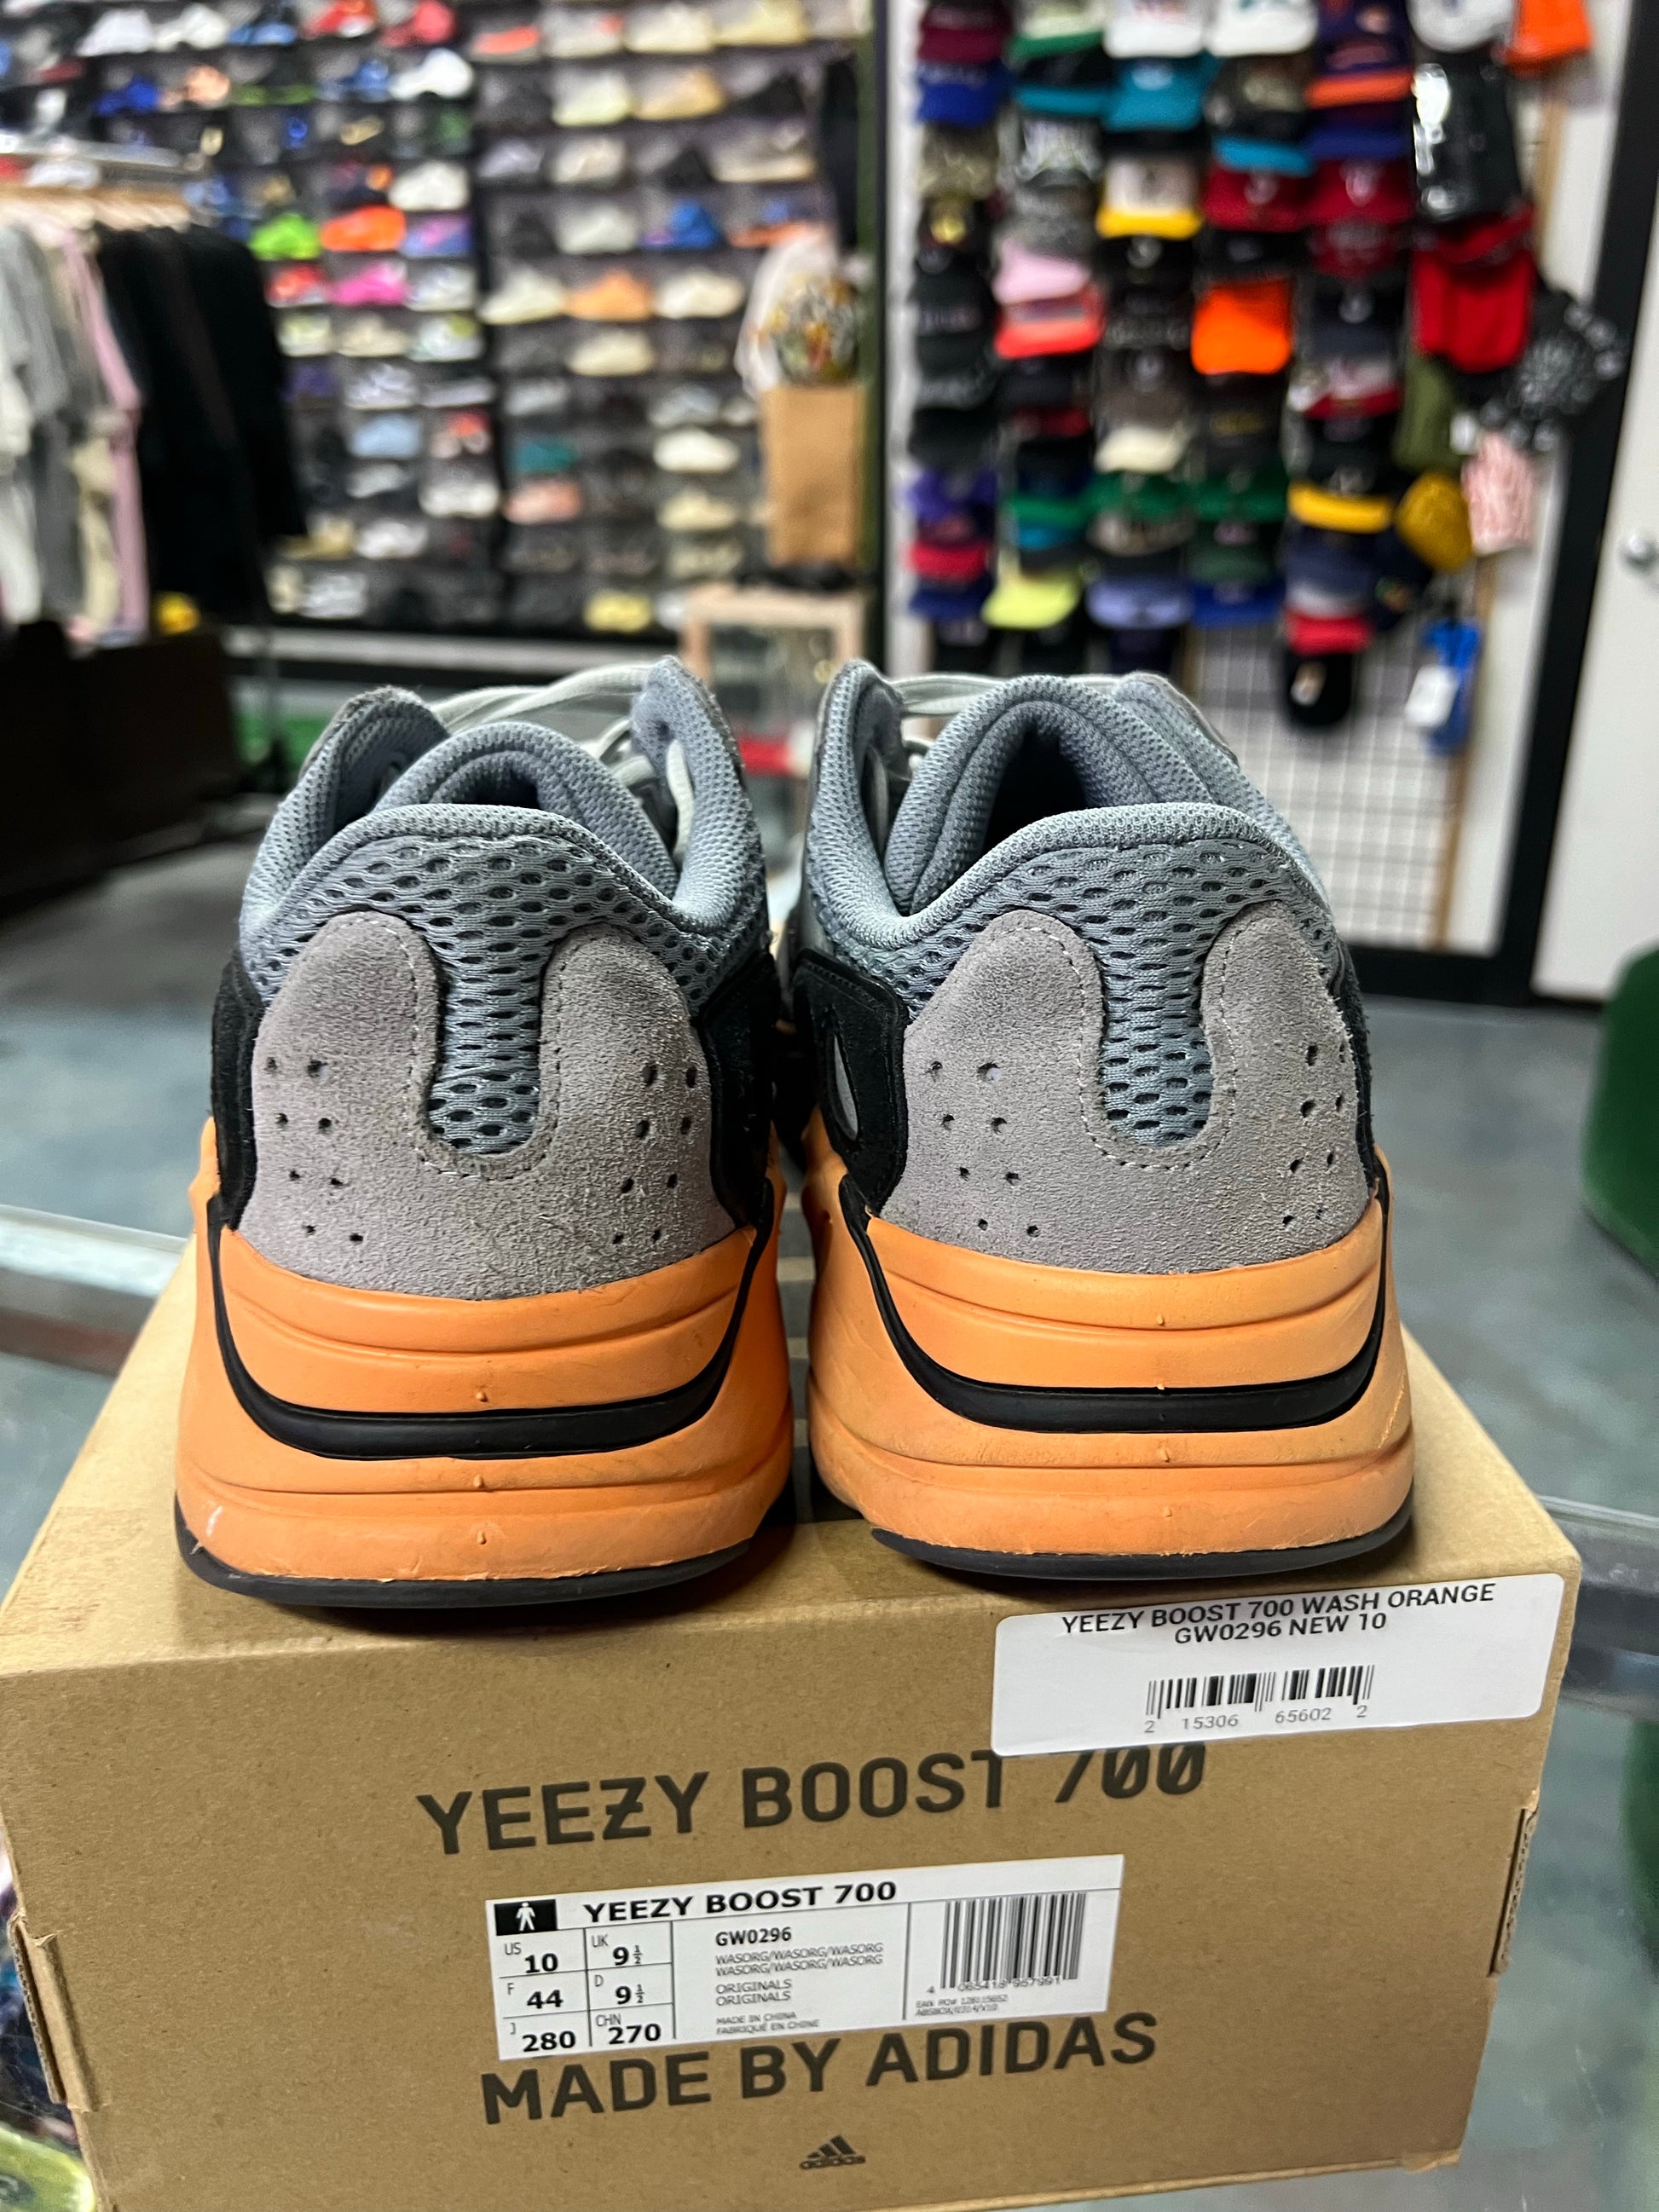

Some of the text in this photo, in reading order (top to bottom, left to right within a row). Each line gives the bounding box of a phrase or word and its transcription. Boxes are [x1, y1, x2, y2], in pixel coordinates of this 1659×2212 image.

[1062, 1583, 1496, 1633] YEEZY BOOST 700 WASH ORANGE
[1175, 1612, 1387, 1643] GW0296 NEW 10
[1143, 1705, 1368, 1734] 2 15306 65602 2
[416, 1771, 709, 1855] YEEZY
[742, 1750, 1002, 1828] BOOST
[583, 1880, 897, 1923] YEEZY BOOST 700
[592, 1934, 609, 1948] UK
[715, 1926, 793, 1947] GW0296
[504, 1942, 522, 1955] US
[715, 1942, 884, 1966] WASORG/WASORG/WASORG
[524, 1953, 558, 1973] 10
[715, 1954, 884, 1977] WASORG/WASORG/WASORG
[506, 1982, 515, 1995] F
[594, 1974, 604, 1987] D
[715, 1978, 793, 1995] ORIGINALS
[526, 1989, 564, 2010] 44
[715, 1990, 792, 2006] ORIGINALS
[596, 2013, 621, 2027] CHN
[716, 2012, 797, 2025] MADE IN CHINA
[521, 2030, 576, 2053] 280
[608, 2023, 662, 2045] 270
[481, 2012, 1158, 2125] MADE BY ADIDAS
